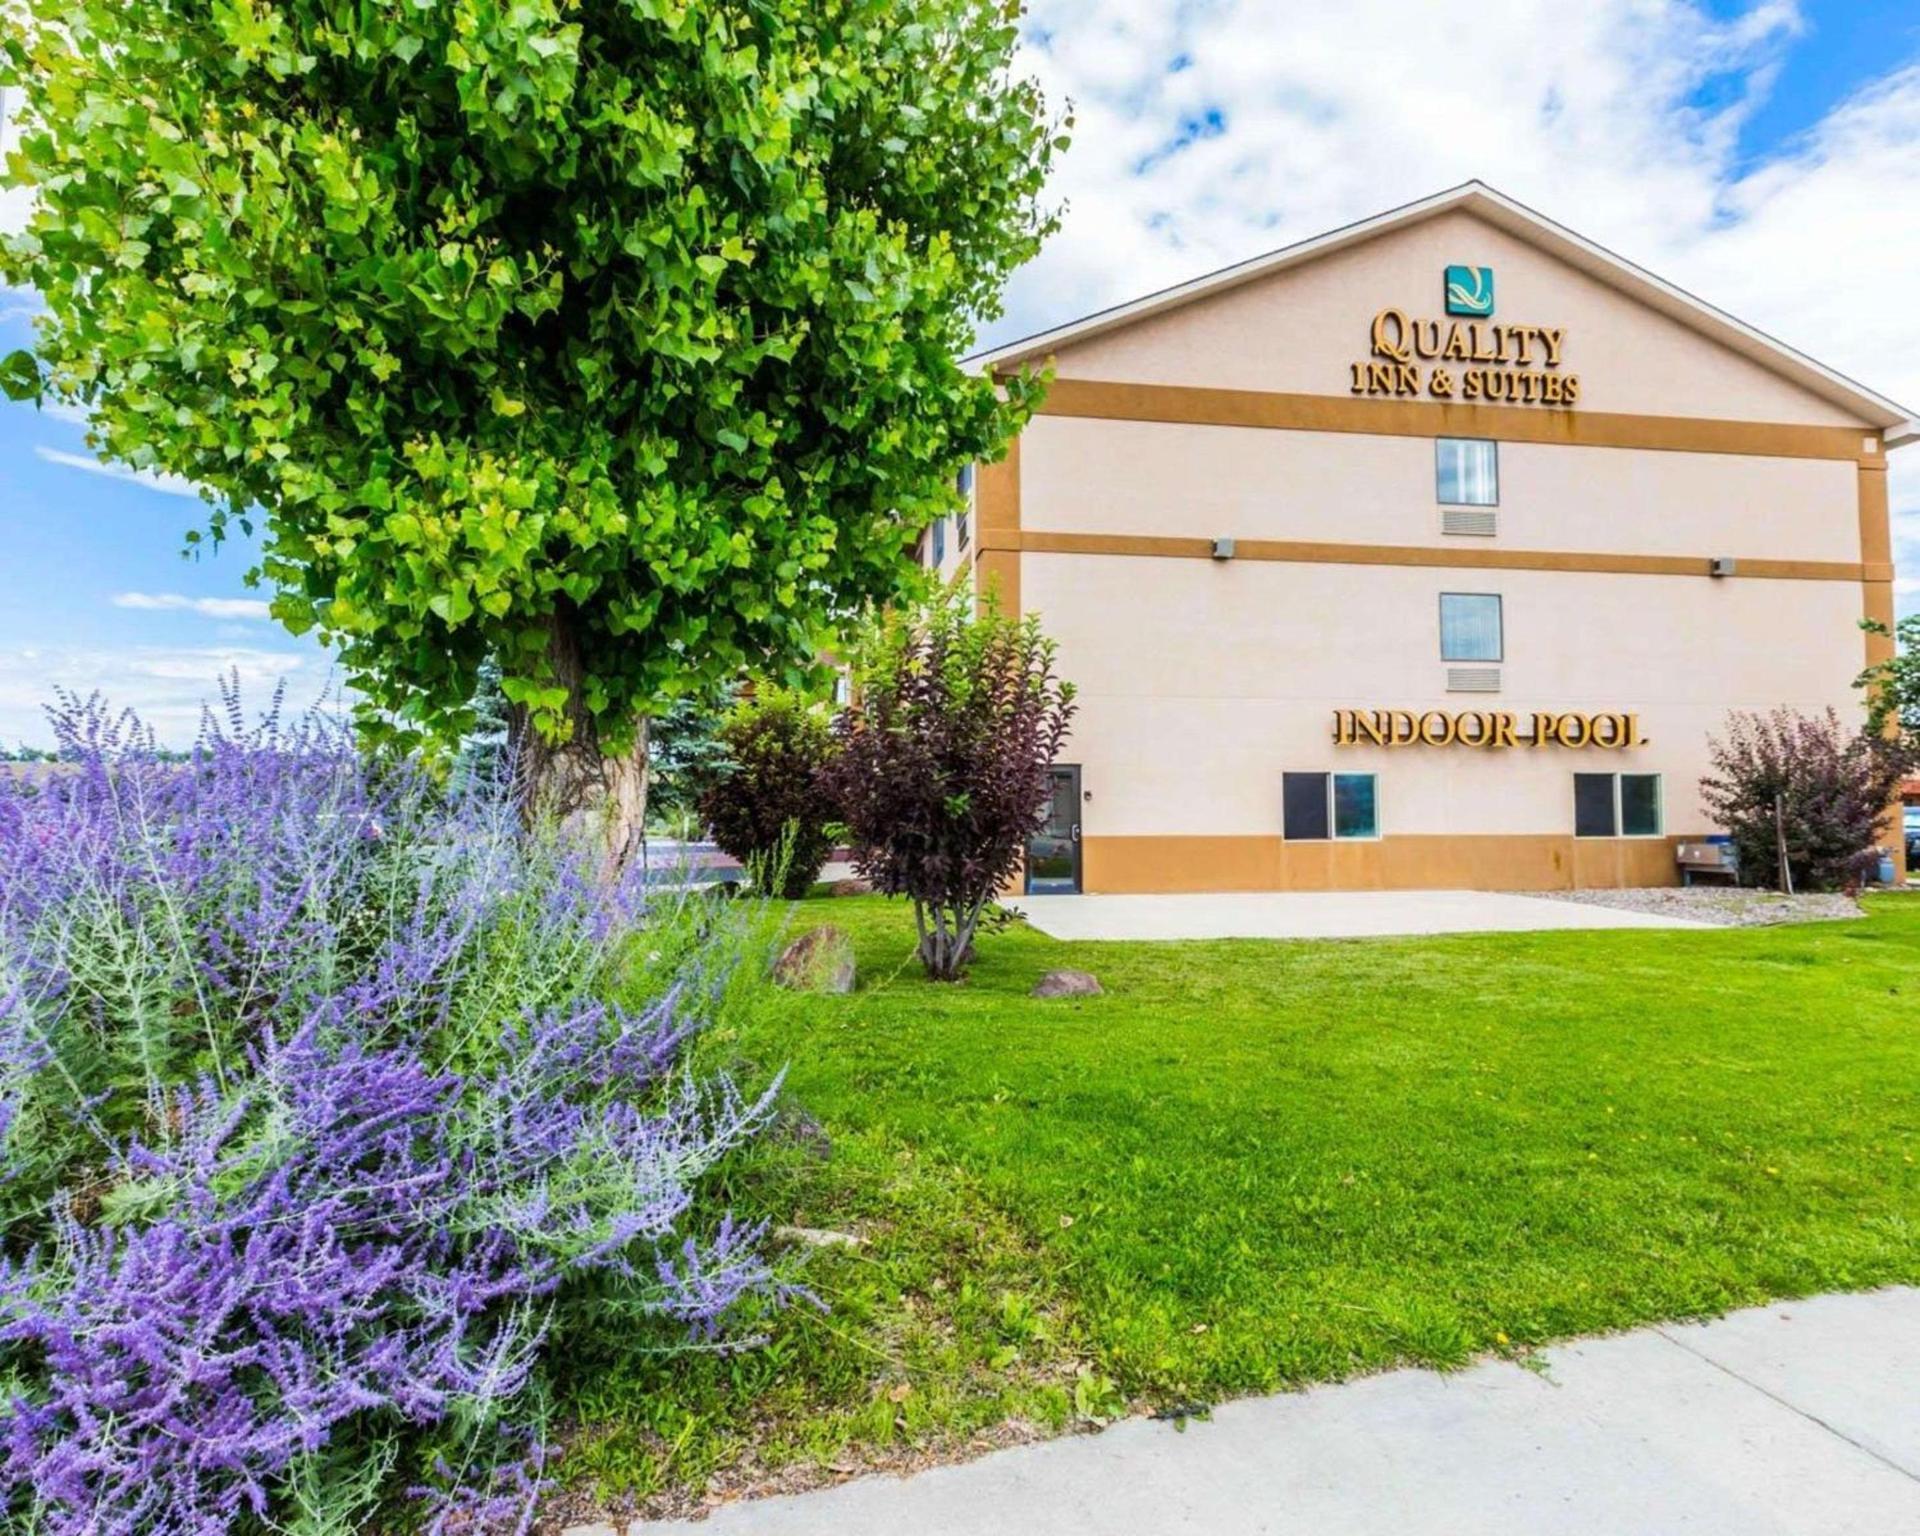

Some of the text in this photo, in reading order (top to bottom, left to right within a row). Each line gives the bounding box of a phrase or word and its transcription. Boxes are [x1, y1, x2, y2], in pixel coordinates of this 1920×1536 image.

[1371, 307, 1567, 366] QUALITY
[1351, 361, 1581, 404] INN & SUITES
[1332, 709, 1649, 748] INDOOR POOL
